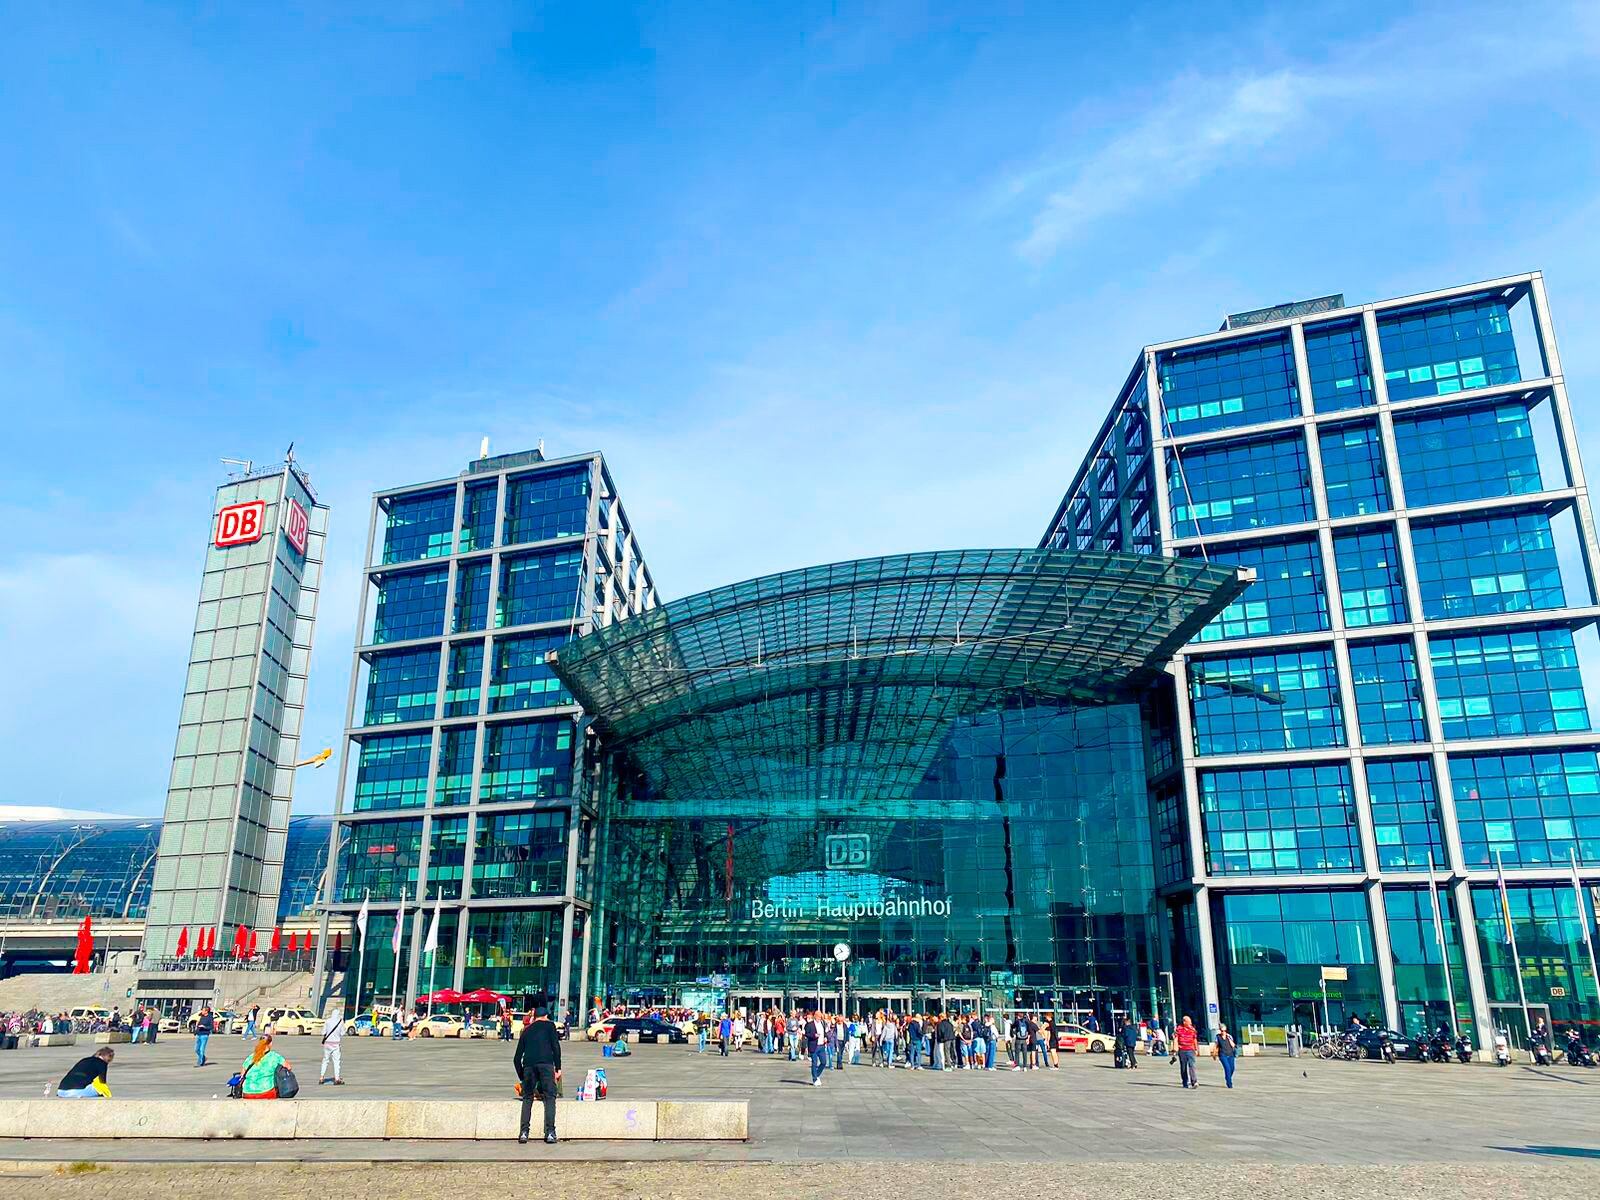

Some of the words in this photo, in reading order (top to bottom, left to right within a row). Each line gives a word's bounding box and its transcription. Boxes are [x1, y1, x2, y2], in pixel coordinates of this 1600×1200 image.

[221, 508, 258, 539] DB
[290, 502, 305, 545] DB
[831, 839, 865, 864] DB
[751, 898, 803, 919] Berlin
[817, 895, 952, 921] Hauptbahnhof
